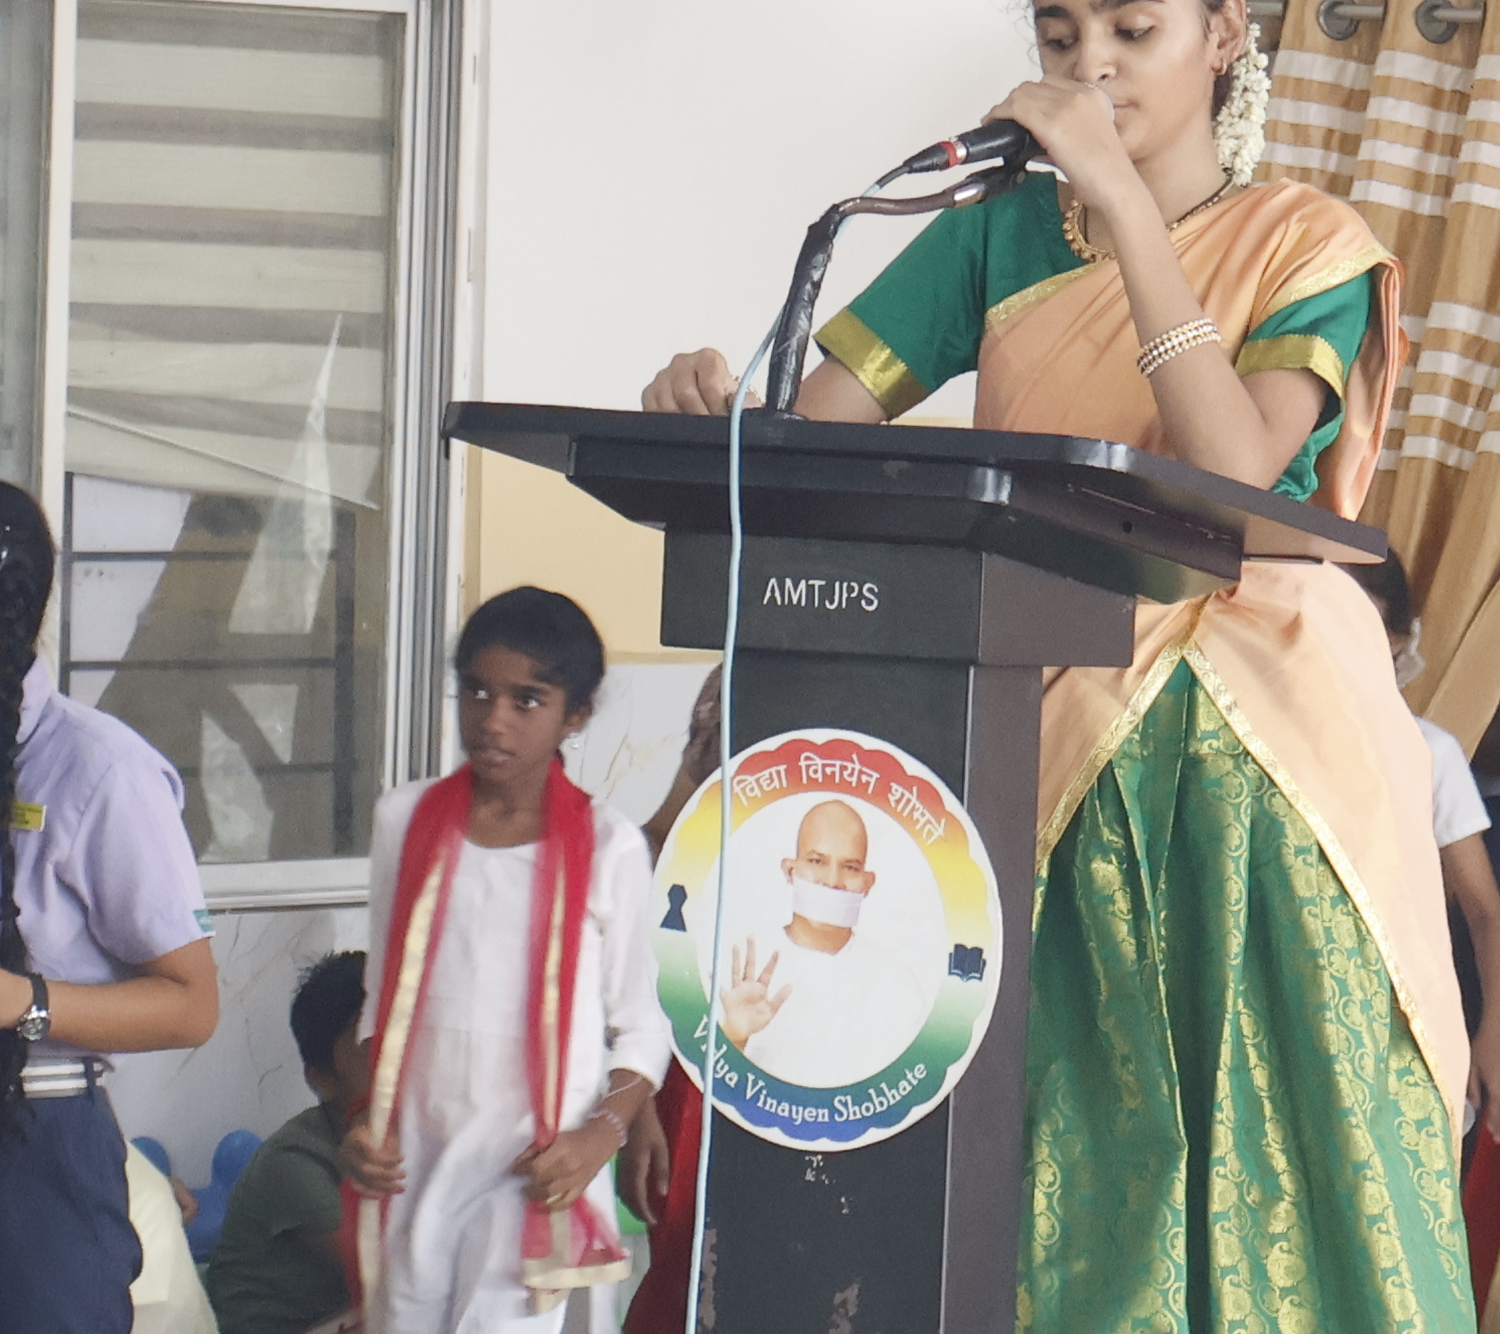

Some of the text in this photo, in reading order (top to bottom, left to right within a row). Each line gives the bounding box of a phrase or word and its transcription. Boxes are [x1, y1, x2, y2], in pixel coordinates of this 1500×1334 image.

[763, 577, 879, 611] AMTJPS
[733, 751, 947, 846] विद्या विनयेन शोभते
[693, 1014, 928, 1125] Vdya Vinayen Shobhate
